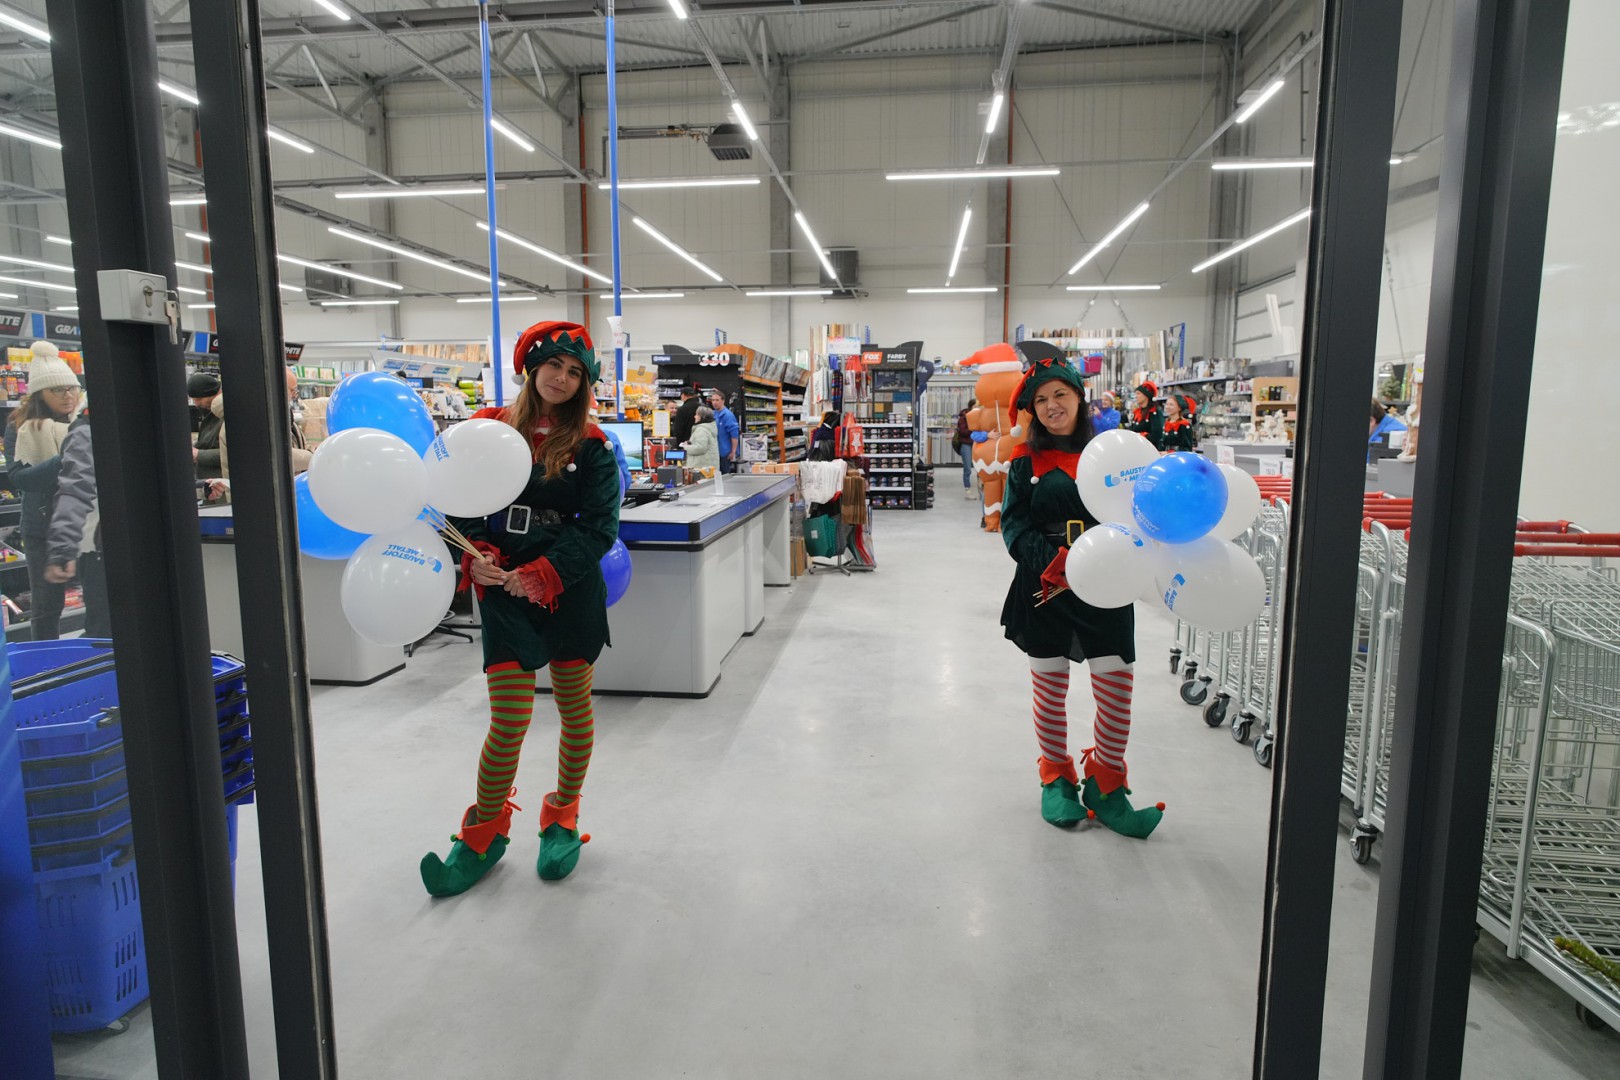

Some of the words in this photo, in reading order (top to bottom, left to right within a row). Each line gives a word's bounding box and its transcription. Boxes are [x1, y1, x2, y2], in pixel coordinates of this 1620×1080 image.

[0, 315, 21, 326] ITE
[387, 544, 419, 556] METALL
[382, 550, 425, 566] BAUSTOFF
